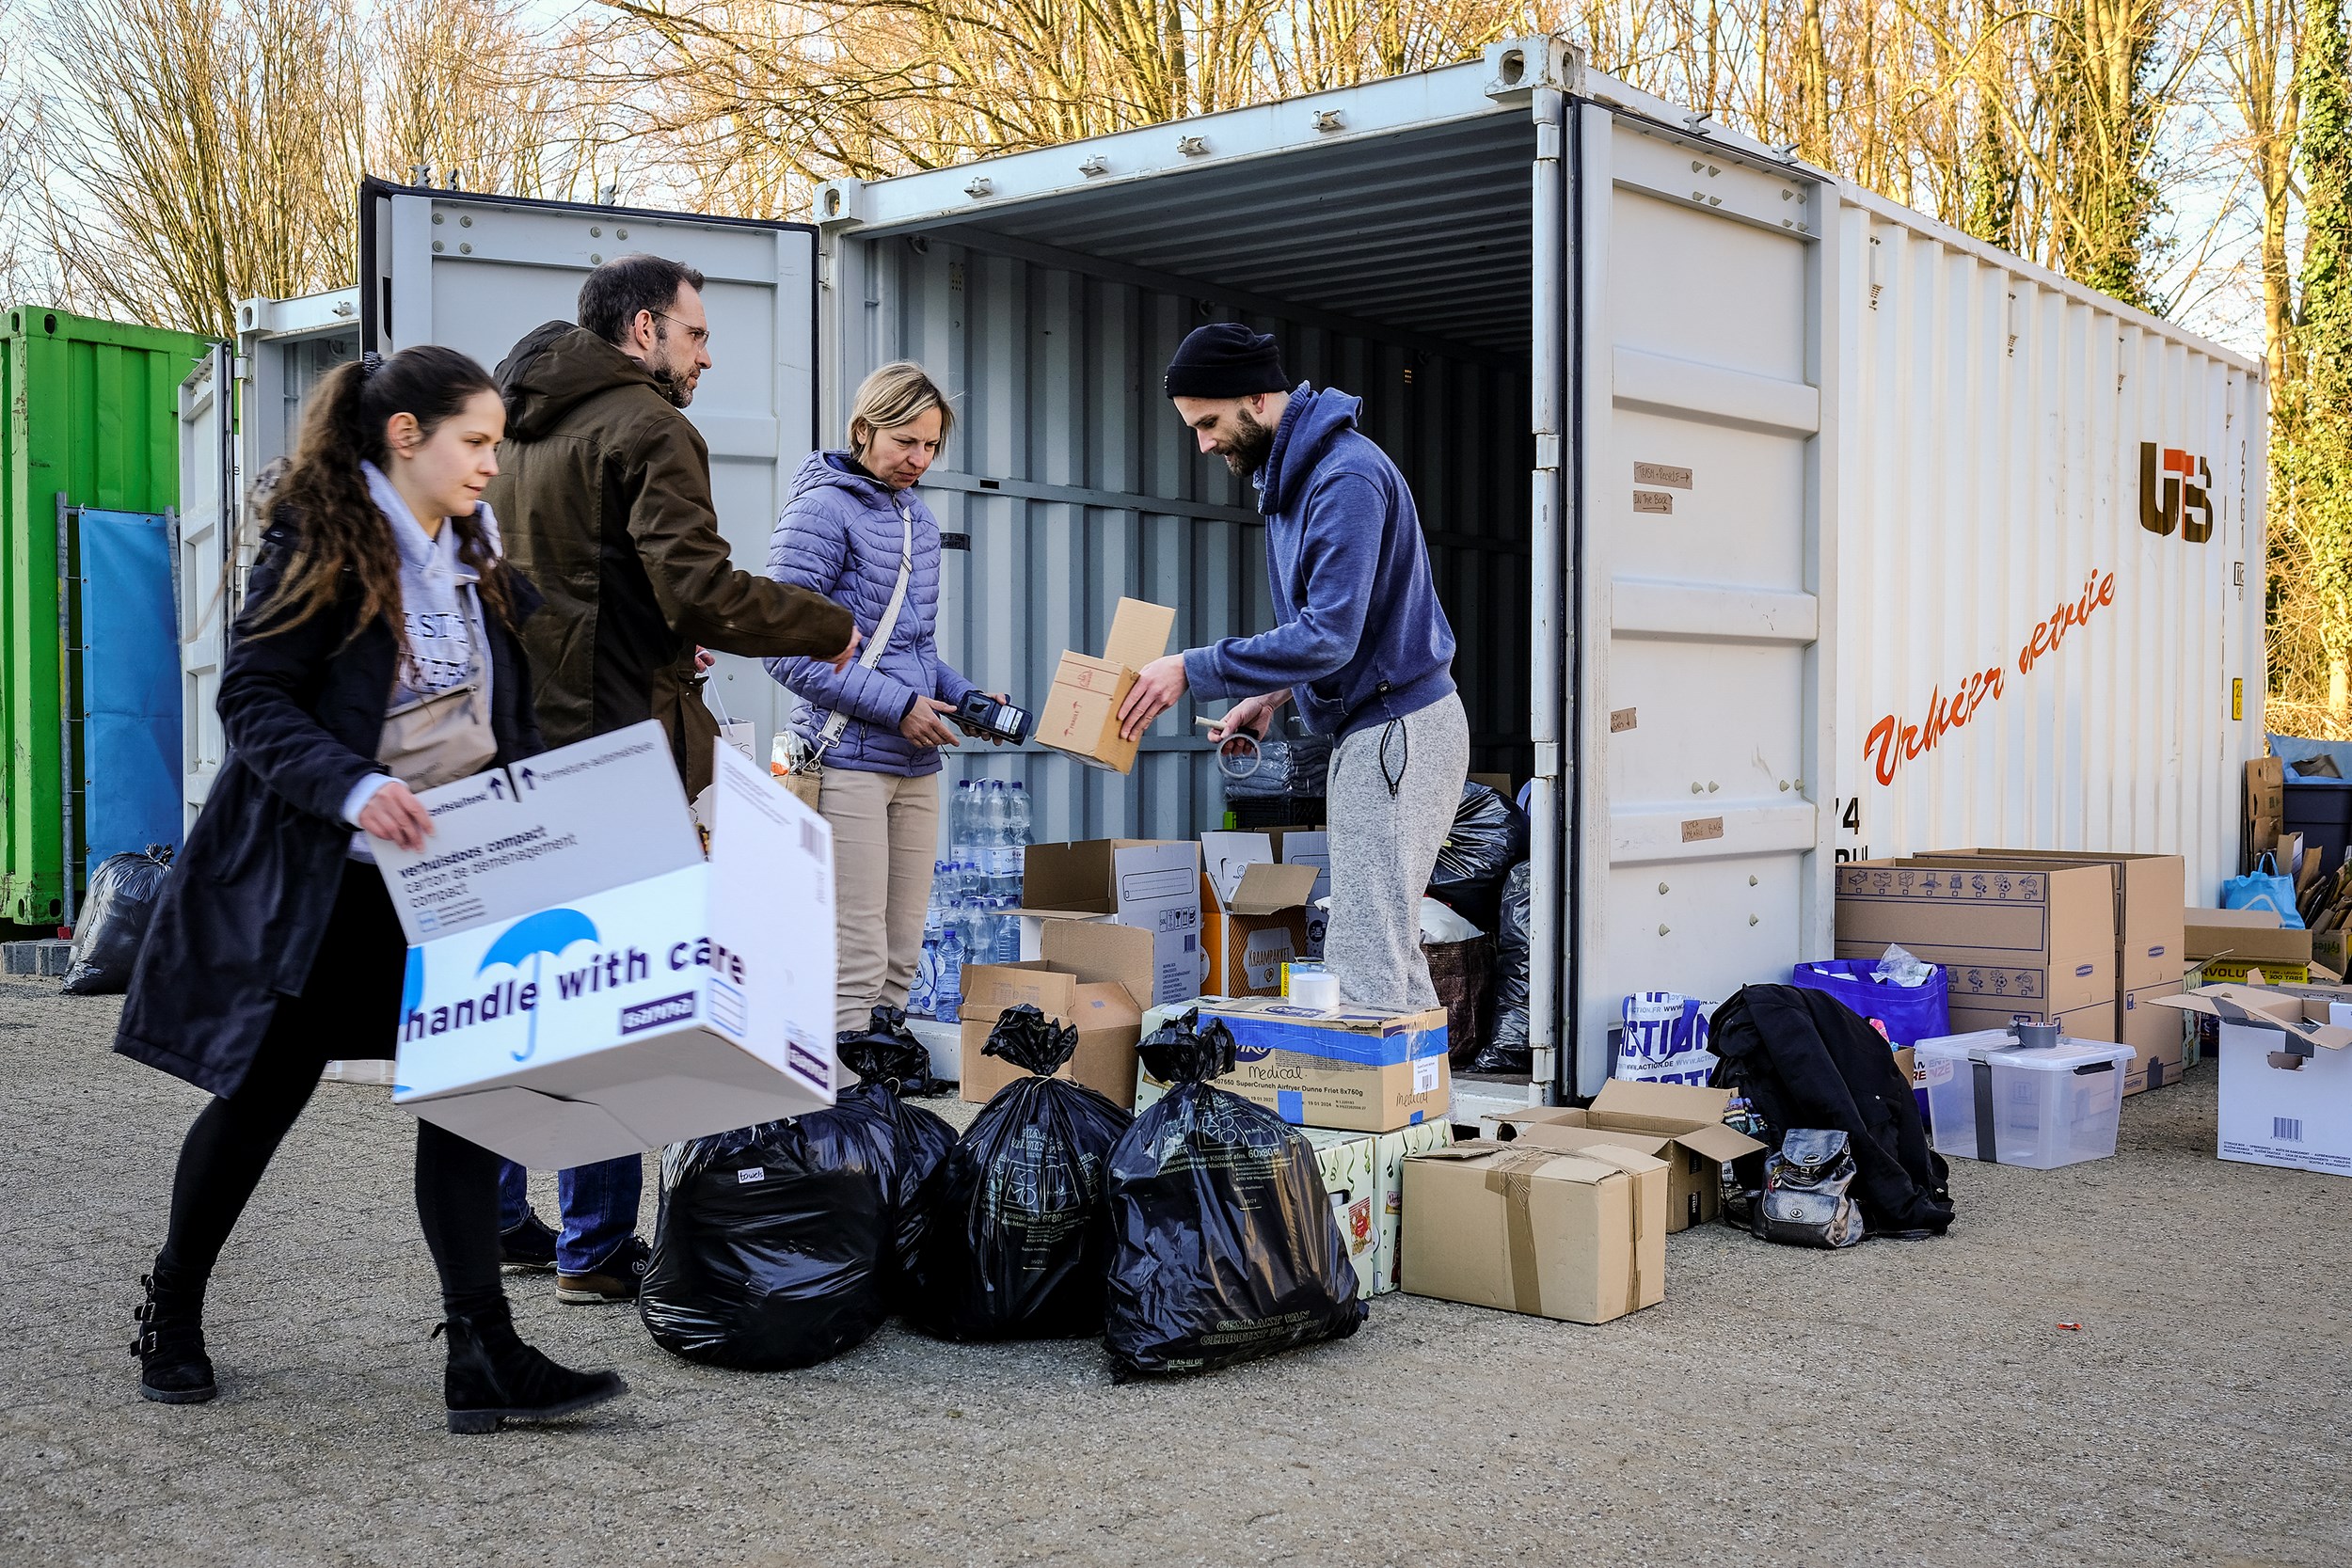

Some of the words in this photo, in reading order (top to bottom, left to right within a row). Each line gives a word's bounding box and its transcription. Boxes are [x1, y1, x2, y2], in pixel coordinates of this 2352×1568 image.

[1248, 946, 1290, 968] KRAAMPAKKET
[405, 978, 539, 1042] handle
[557, 944, 652, 1001] with
[668, 936, 746, 986] care
[1235, 1080, 1276, 1090] SuperCrunch
[1277, 1084, 1300, 1092] Airfryer
[739, 1170, 764, 1181] towels
[1216, 1314, 1282, 1332] GEMAAKT
[1200, 1328, 1268, 1346] GEBRUIKT
